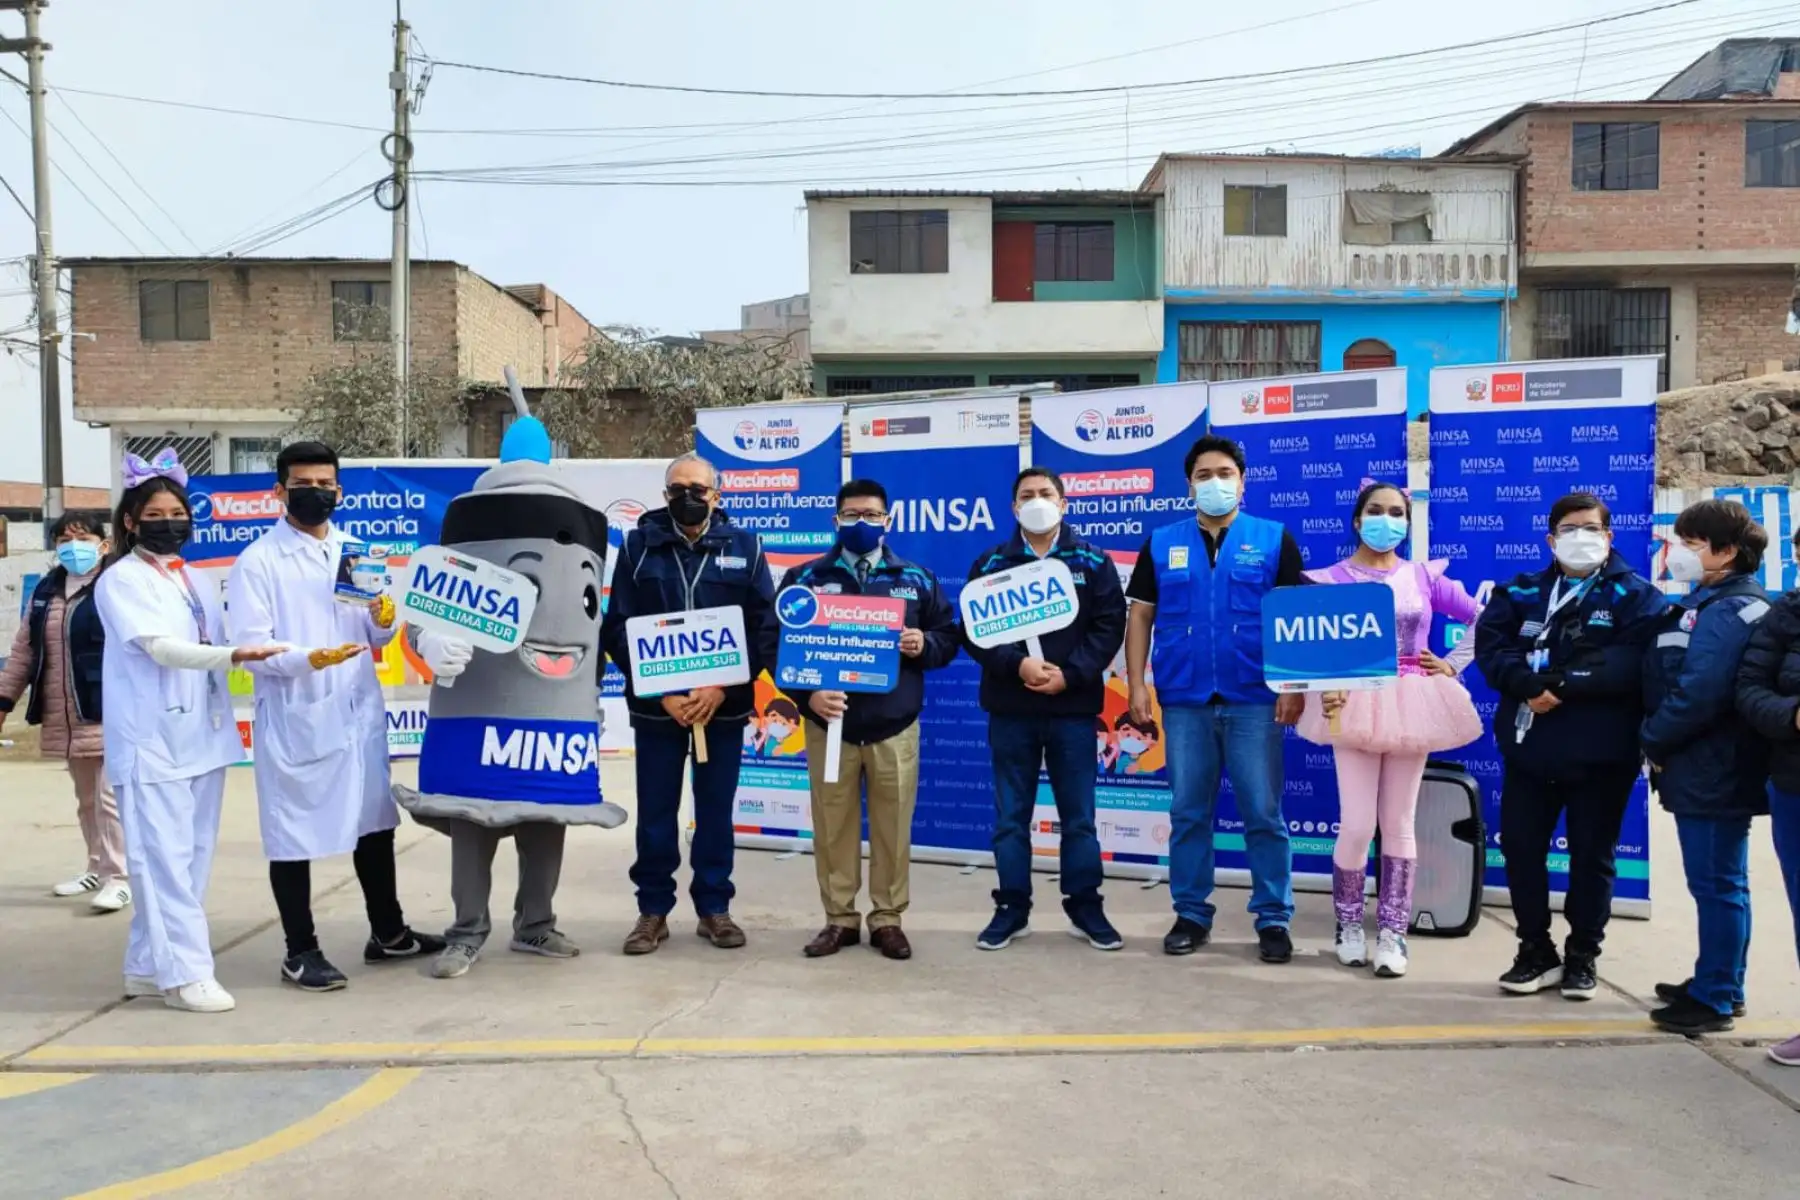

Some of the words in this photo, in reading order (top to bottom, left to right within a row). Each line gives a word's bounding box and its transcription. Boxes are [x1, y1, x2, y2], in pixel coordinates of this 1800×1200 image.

[1115, 405, 1145, 416] JUNTOS
[1106, 426, 1121, 441] AL
[1335, 432, 1376, 445] MINSA
[1497, 427, 1542, 439] MINSA
[1571, 425, 1618, 437] MINSA
[760, 437, 773, 450] AL
[1270, 436, 1309, 448] MINSA
[1302, 462, 1343, 474] MINSA
[1461, 457, 1505, 469] MINSA
[1533, 455, 1580, 467] MINSA
[721, 470, 797, 488] Vacúnate
[1062, 473, 1151, 492] Vacúnate
[405, 488, 425, 509] la
[1270, 491, 1310, 503] MINSA
[1497, 485, 1541, 498] MINSA
[718, 494, 754, 509] ontra
[756, 493, 769, 508] la
[771, 492, 836, 508] influenza
[1066, 499, 1099, 515] ntra
[1101, 497, 1117, 513] la
[729, 513, 790, 529] eumonía
[1070, 518, 1143, 536] eumonía
[1303, 517, 1344, 530] MINSA
[1460, 515, 1504, 527] MINSA
[1496, 543, 1540, 555] MINSA
[412, 564, 519, 625] MINSA
[968, 576, 1066, 622] MINSA
[410, 595, 445, 615] DIRIS
[448, 609, 481, 629] LIMA
[485, 622, 513, 640] SUR
[823, 604, 899, 622] Vacúnate
[978, 620, 1009, 637] DIRIS
[1012, 610, 1042, 626] LIMA
[1044, 602, 1069, 617] SUR
[1274, 612, 1383, 643] MINSA
[637, 627, 738, 660] MINSA
[785, 632, 826, 645] contra
[827, 634, 838, 645] la
[840, 634, 894, 650] influenza
[804, 651, 813, 661] y
[643, 663, 676, 675] DIRIS
[679, 659, 709, 671] LIMA
[712, 654, 737, 666] SUR
[1476, 702, 1500, 713] NSA
[386, 710, 428, 730] MIN
[481, 725, 599, 776] MINSA
[1305, 754, 1334, 764] MIN
[1285, 780, 1314, 791] INSA
